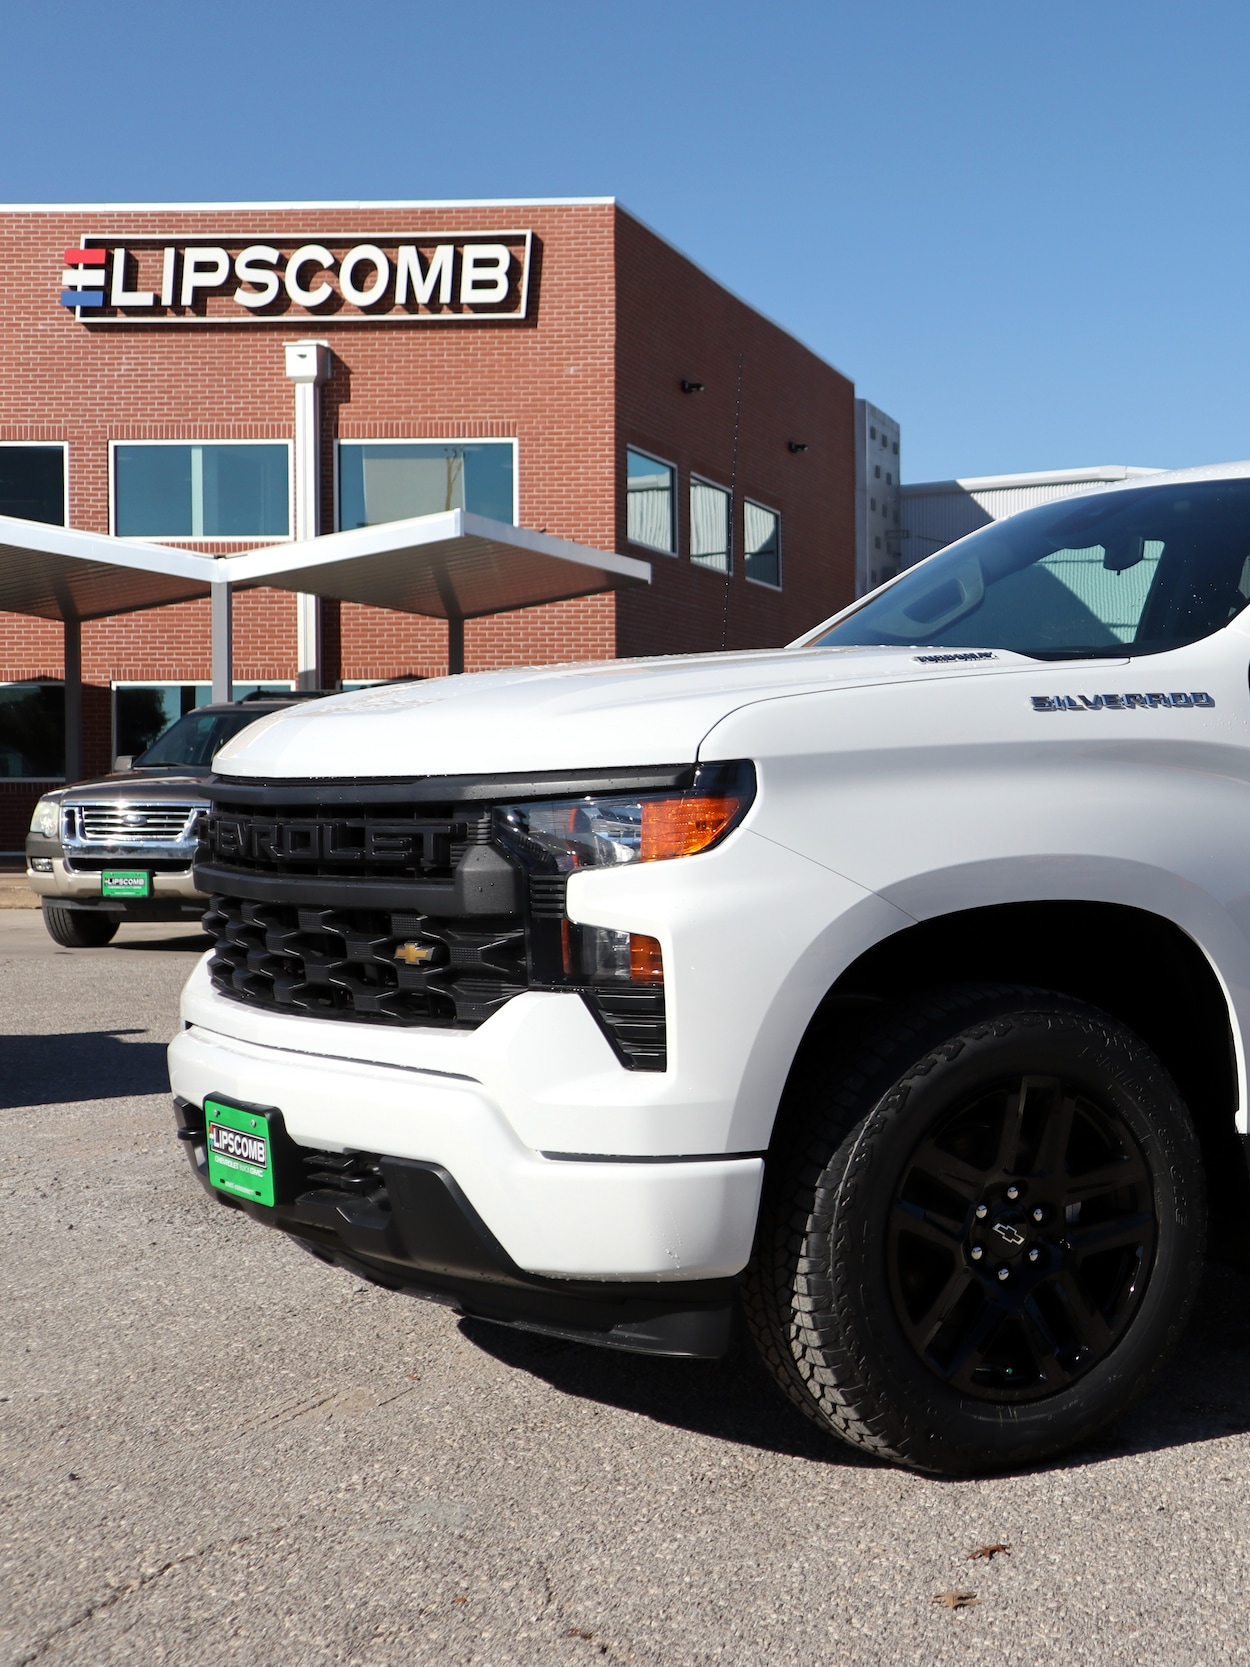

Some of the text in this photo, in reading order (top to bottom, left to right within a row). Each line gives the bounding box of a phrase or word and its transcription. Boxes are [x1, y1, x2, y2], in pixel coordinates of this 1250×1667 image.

[110, 244, 511, 307] LIPSCOMB
[1030, 692, 1214, 712] SILVERADO
[213, 1127, 266, 1163] LIPSCOMB
